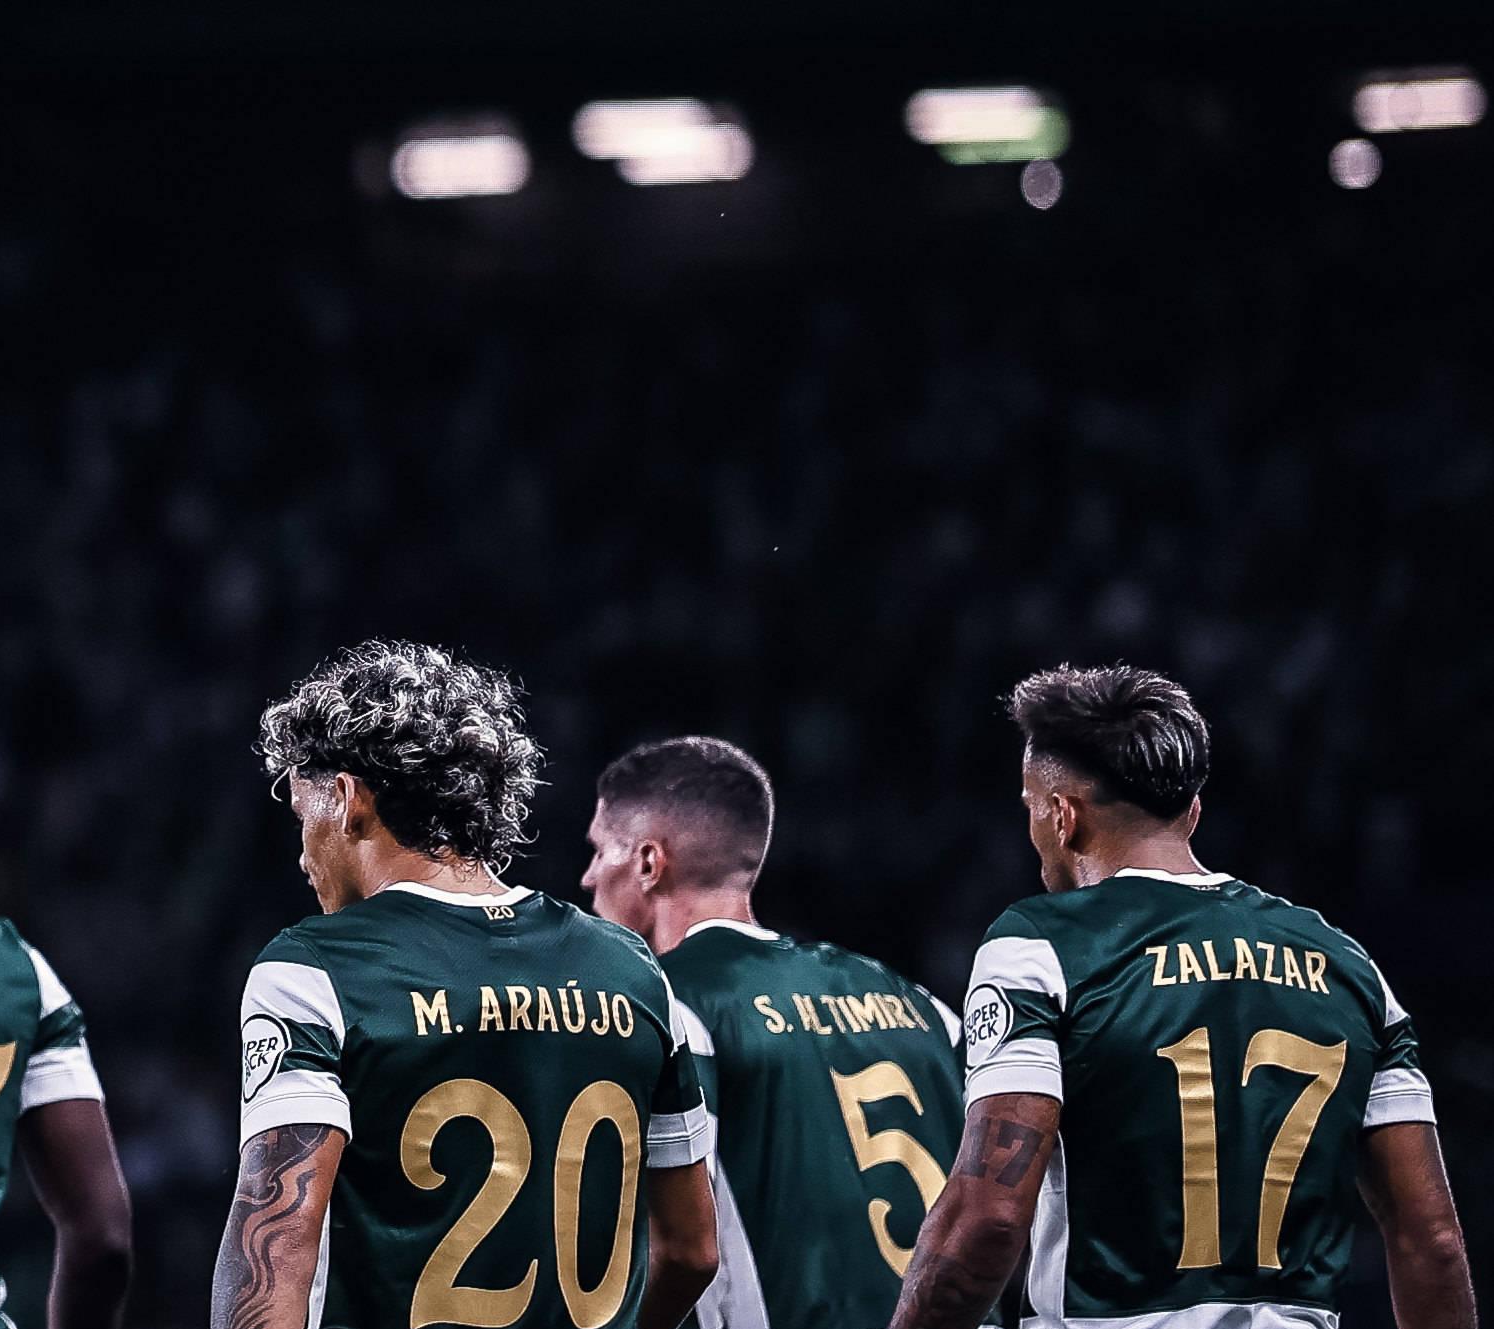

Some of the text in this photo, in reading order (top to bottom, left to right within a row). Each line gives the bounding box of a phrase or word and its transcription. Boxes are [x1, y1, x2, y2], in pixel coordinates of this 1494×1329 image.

[1145, 937, 1330, 995] ZALAZAR
[410, 979, 635, 1039] M. ARAÚJO
[753, 993, 794, 1035] S.
[244, 1037, 279, 1056] PER
[828, 1060, 948, 1279] 5
[1155, 1025, 1348, 1271] 17
